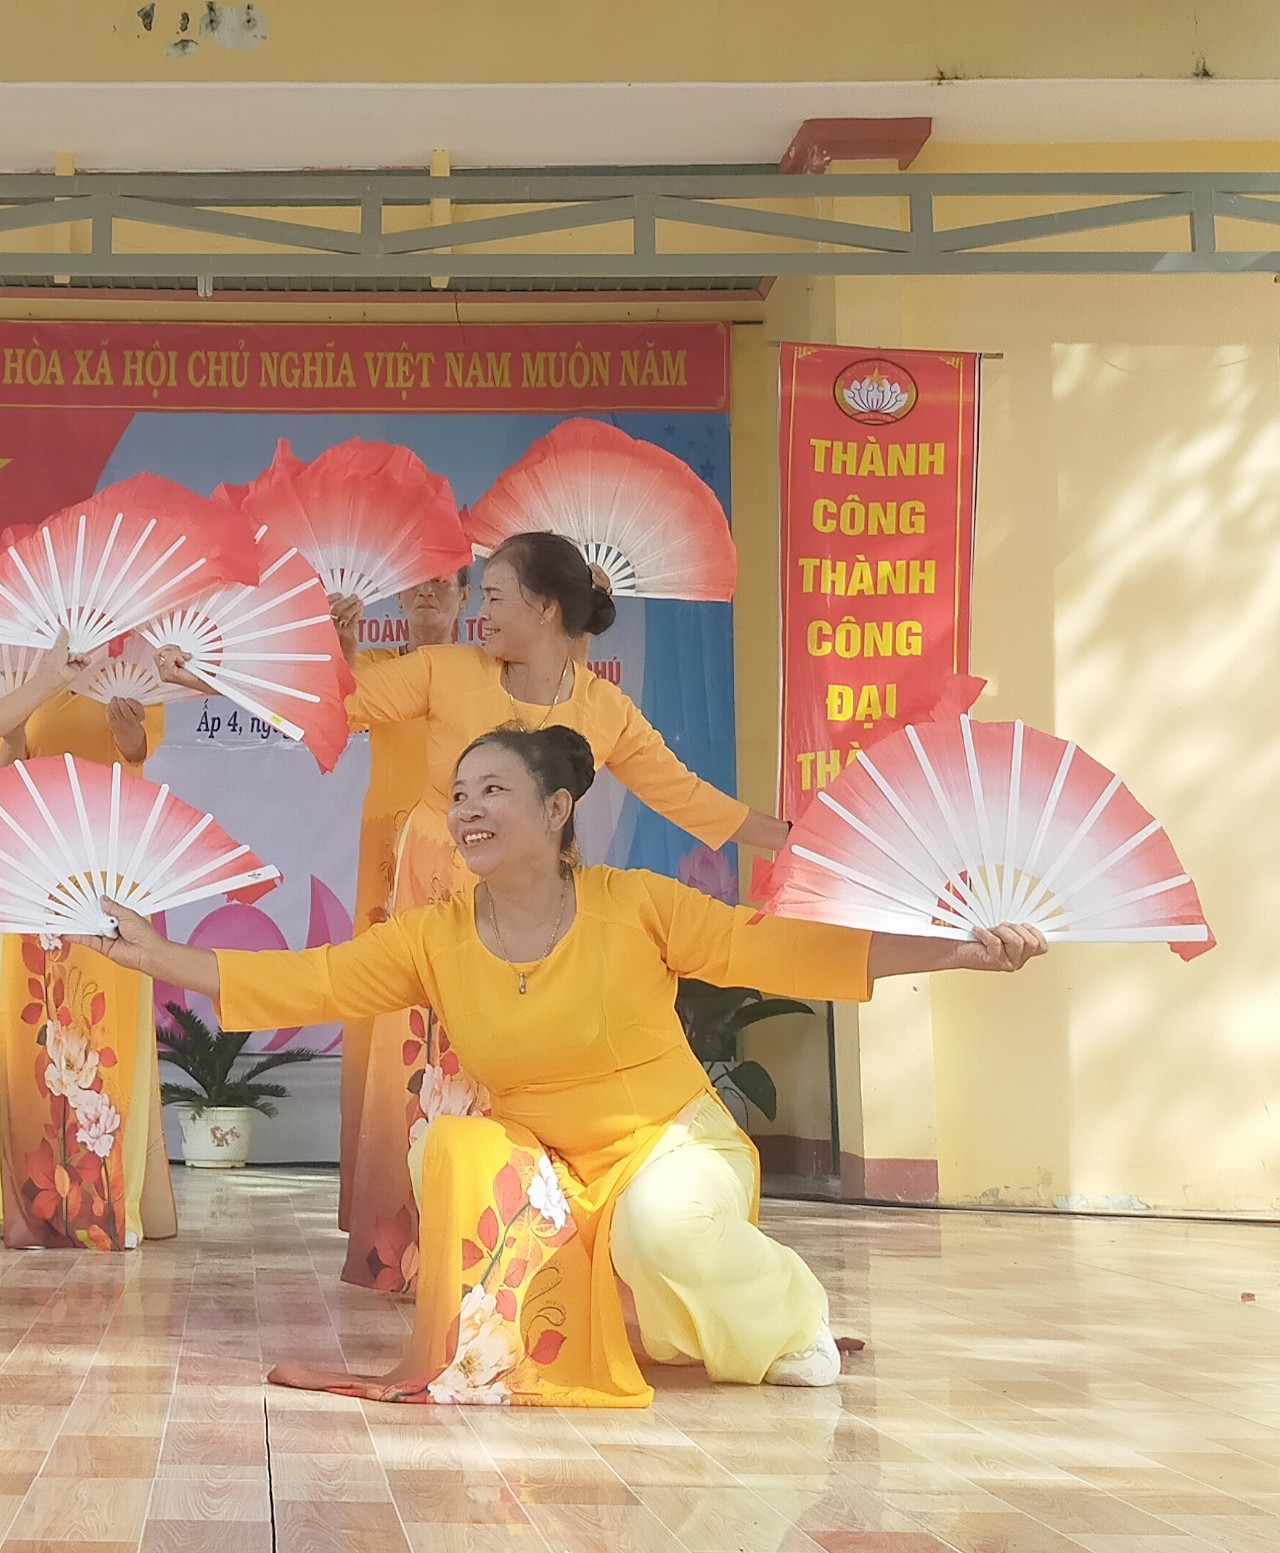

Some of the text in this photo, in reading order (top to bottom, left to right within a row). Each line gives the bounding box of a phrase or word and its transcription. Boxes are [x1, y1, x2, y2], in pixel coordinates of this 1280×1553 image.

[2, 336, 65, 385] HÒA
[72, 339, 114, 385] XÃ
[122, 340, 178, 398] HỘI
[187, 339, 250, 388] CHỦ
[259, 341, 357, 388] NGHĨA
[364, 341, 435, 400] VIỆT
[444, 351, 512, 388] NAM
[521, 340, 611, 388] MUÔN
[619, 340, 688, 387] NĂM
[809, 436, 945, 476] THÀNH
[812, 494, 926, 536] CÔNG
[798, 554, 936, 596] THÀNH
[358, 614, 410, 643] TOÀN
[807, 616, 922, 659] CÔNG
[196, 699, 221, 738] Ấp
[227, 711, 243, 735] 4,
[825, 683, 896, 729] ĐẠI
